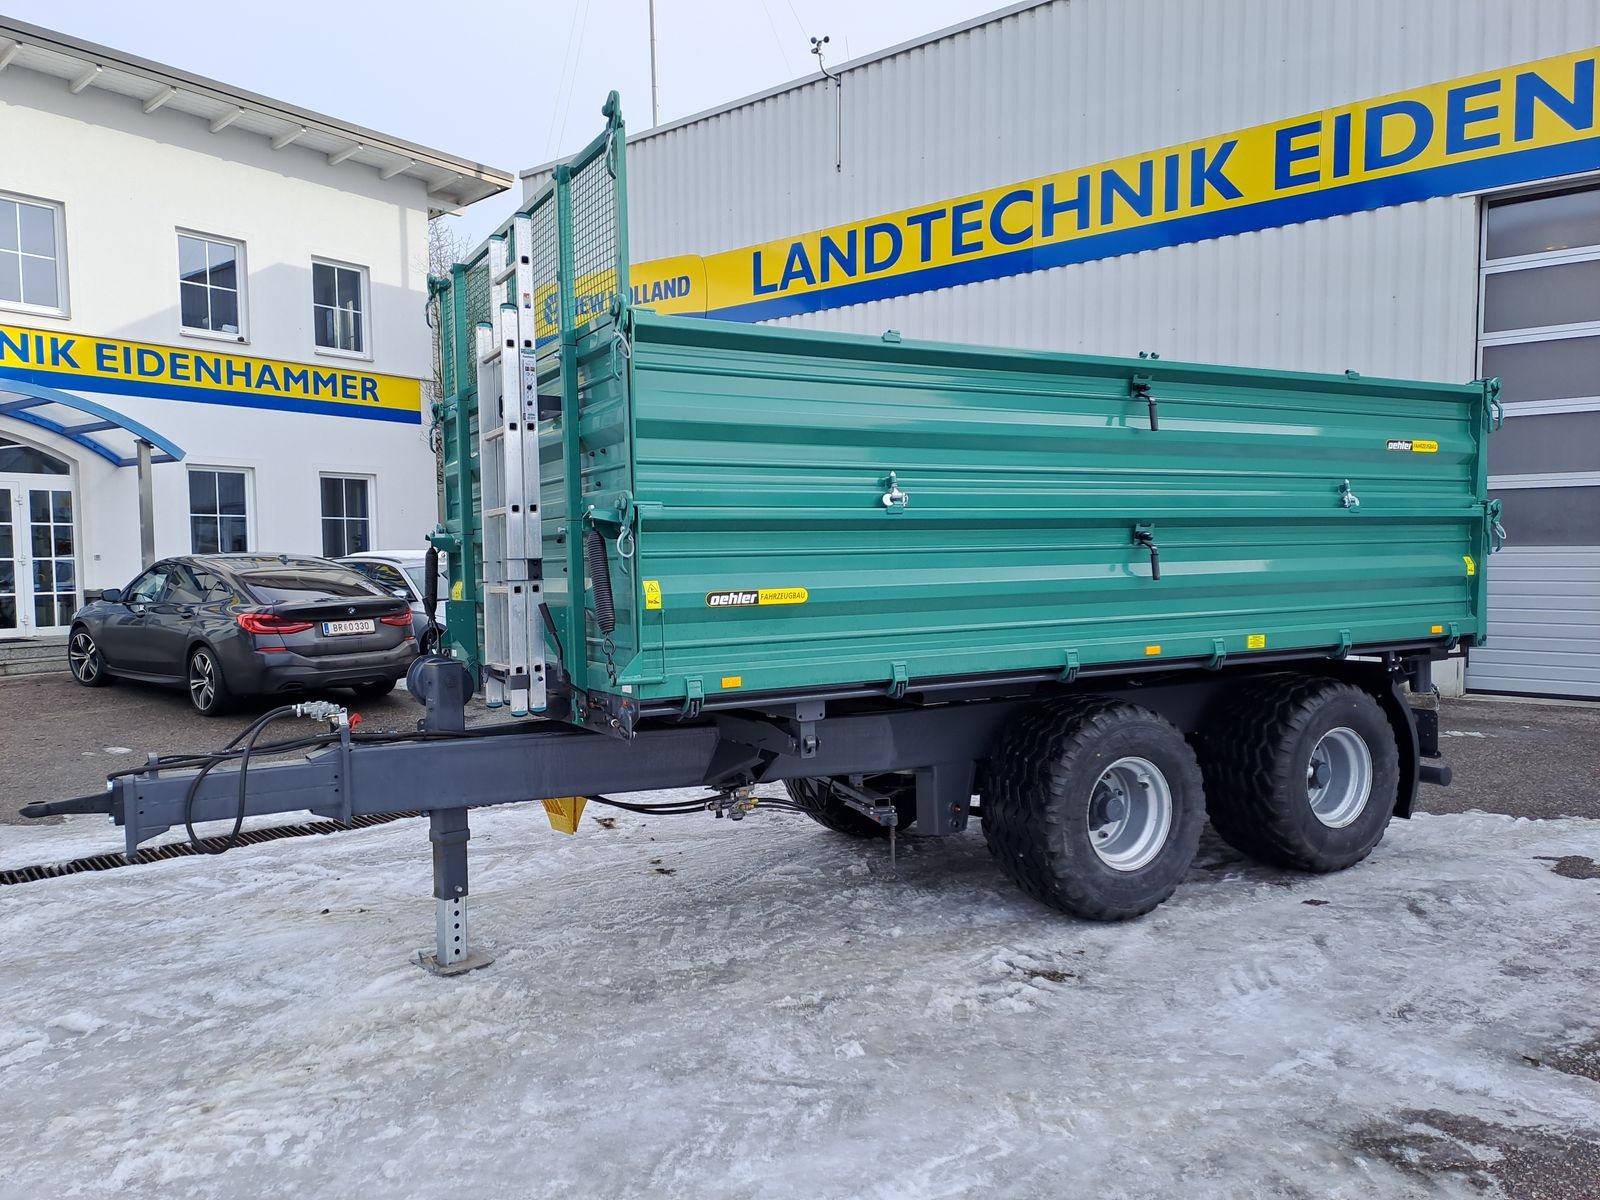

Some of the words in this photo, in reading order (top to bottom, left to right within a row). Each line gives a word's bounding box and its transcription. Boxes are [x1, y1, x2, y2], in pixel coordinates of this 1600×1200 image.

[753, 139, 1244, 295] LANDTECHNIK
[1274, 58, 1595, 190] EIDEN
[0, 330, 80, 369] NIK
[95, 342, 380, 402] EIDENHAMMER
[710, 592, 757, 606] oehler
[760, 591, 806, 601] FAHRZEUGBAU
[333, 623, 344, 632] BR
